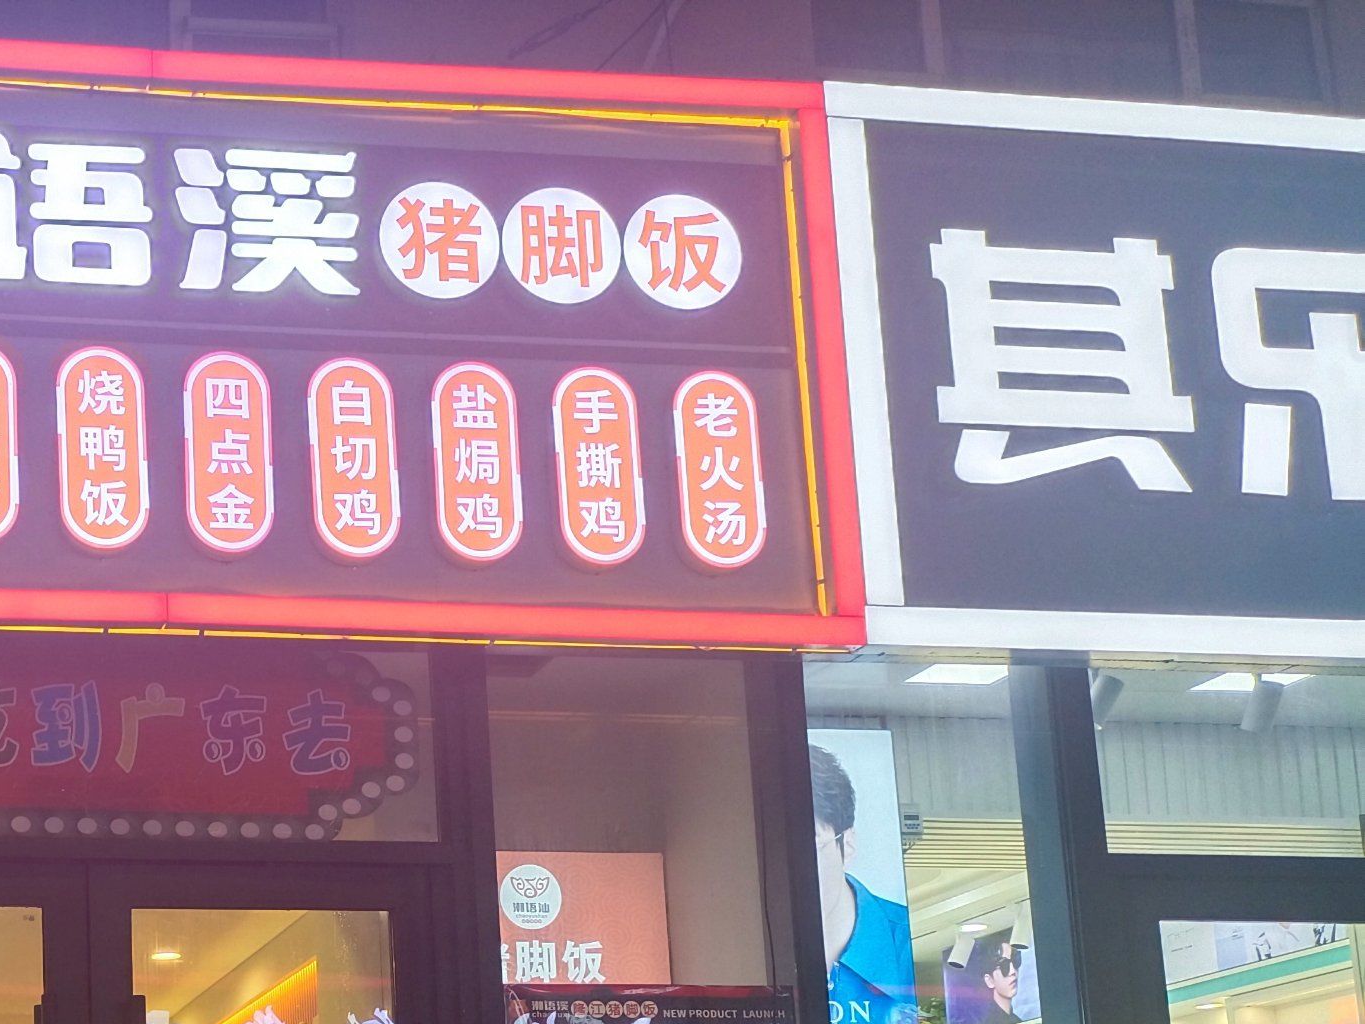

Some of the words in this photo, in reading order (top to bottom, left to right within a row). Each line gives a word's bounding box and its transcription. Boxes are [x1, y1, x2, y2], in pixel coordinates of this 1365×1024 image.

[395, 198, 728, 295] 猪脚饭
[77, 370, 130, 528] 烧鸭饭
[204, 379, 255, 531] 四点金
[331, 382, 382, 536] 白切鸡
[451, 384, 503, 539] 盐焗鸡
[573, 390, 626, 544] 手撕鸡
[693, 394, 747, 547] 老火汤
[500, 940, 606, 984] 脚饭
[663, 1009, 687, 1019] NEW
[689, 1009, 738, 1020] PRODUCT
